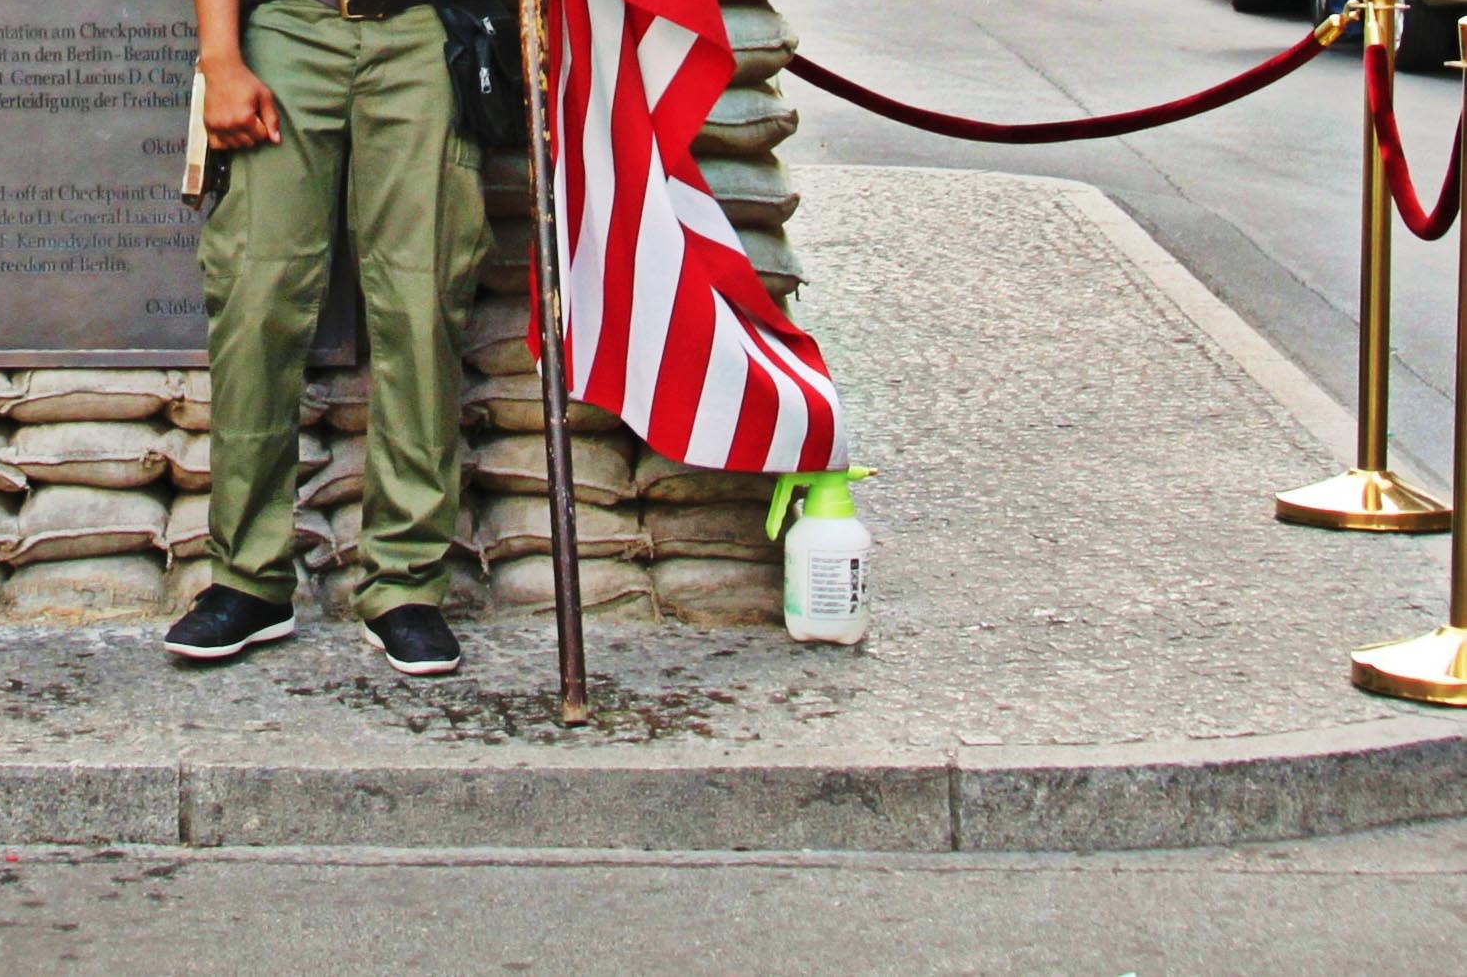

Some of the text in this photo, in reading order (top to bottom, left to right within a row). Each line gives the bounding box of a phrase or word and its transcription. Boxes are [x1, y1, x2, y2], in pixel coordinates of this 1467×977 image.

[51, 27, 76, 40] am
[79, 21, 167, 45] Checkpoint
[170, 21, 199, 40] Cha
[11, 49, 32, 63] an
[34, 45, 63, 63] den
[10, 70, 72, 86] General
[75, 70, 125, 86] Lucius
[93, 93, 118, 109] der
[122, 92, 180, 109] Freiheit
[40, 186, 54, 201] at
[57, 183, 146, 205] Checkpoint
[149, 183, 182, 201] Cha
[19, 210, 34, 224] to
[60, 208, 121, 224] General
[125, 208, 174, 224] Lucius
[91, 232, 113, 249] for
[116, 232, 140, 249] his
[60, 255, 77, 273] of
